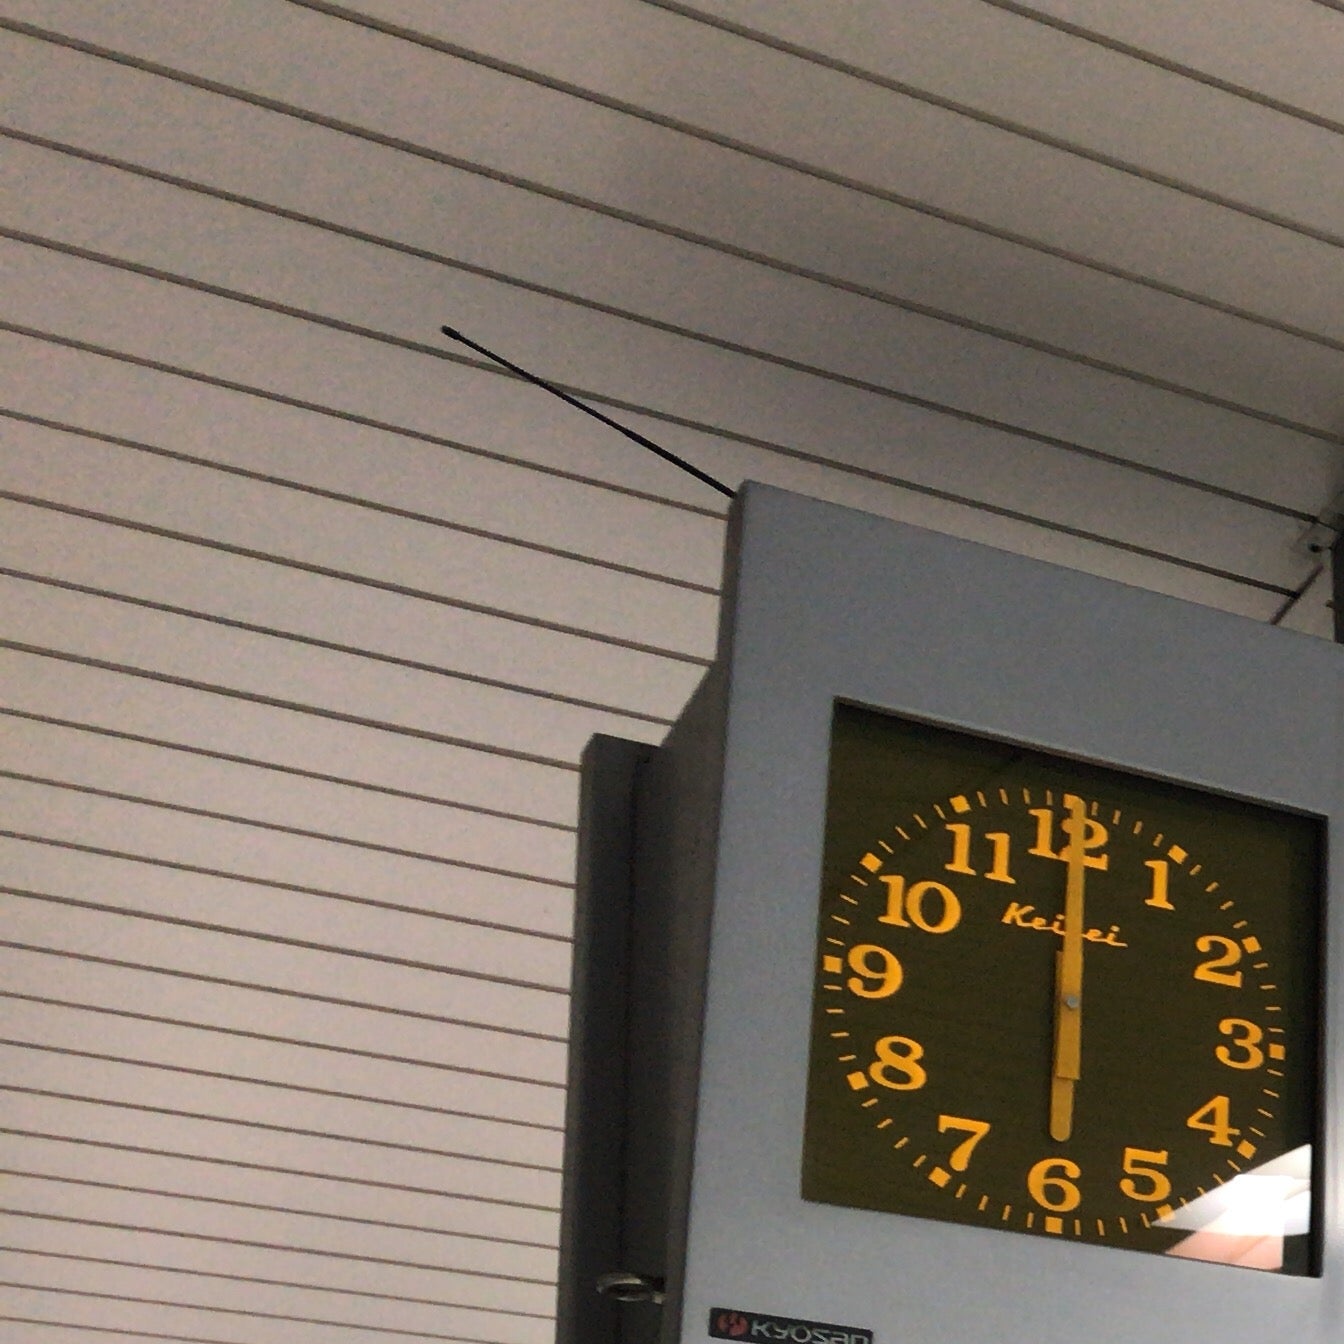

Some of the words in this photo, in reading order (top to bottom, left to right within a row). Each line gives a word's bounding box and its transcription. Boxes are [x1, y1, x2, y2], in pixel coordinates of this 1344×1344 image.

[944, 822, 1016, 885] 11
[1026, 807, 1108, 871] 12
[878, 874, 962, 934] 10
[1143, 859, 1175, 911] 1
[1001, 901, 1128, 948] Keiei
[847, 944, 904, 1000] 9
[1193, 935, 1243, 988] 2
[868, 1035, 928, 1092] 8
[1214, 1018, 1265, 1071] 3
[937, 1114, 991, 1172] 7
[1186, 1095, 1241, 1147] 4
[1027, 1157, 1082, 1213] 6
[1119, 1147, 1172, 1203] 5
